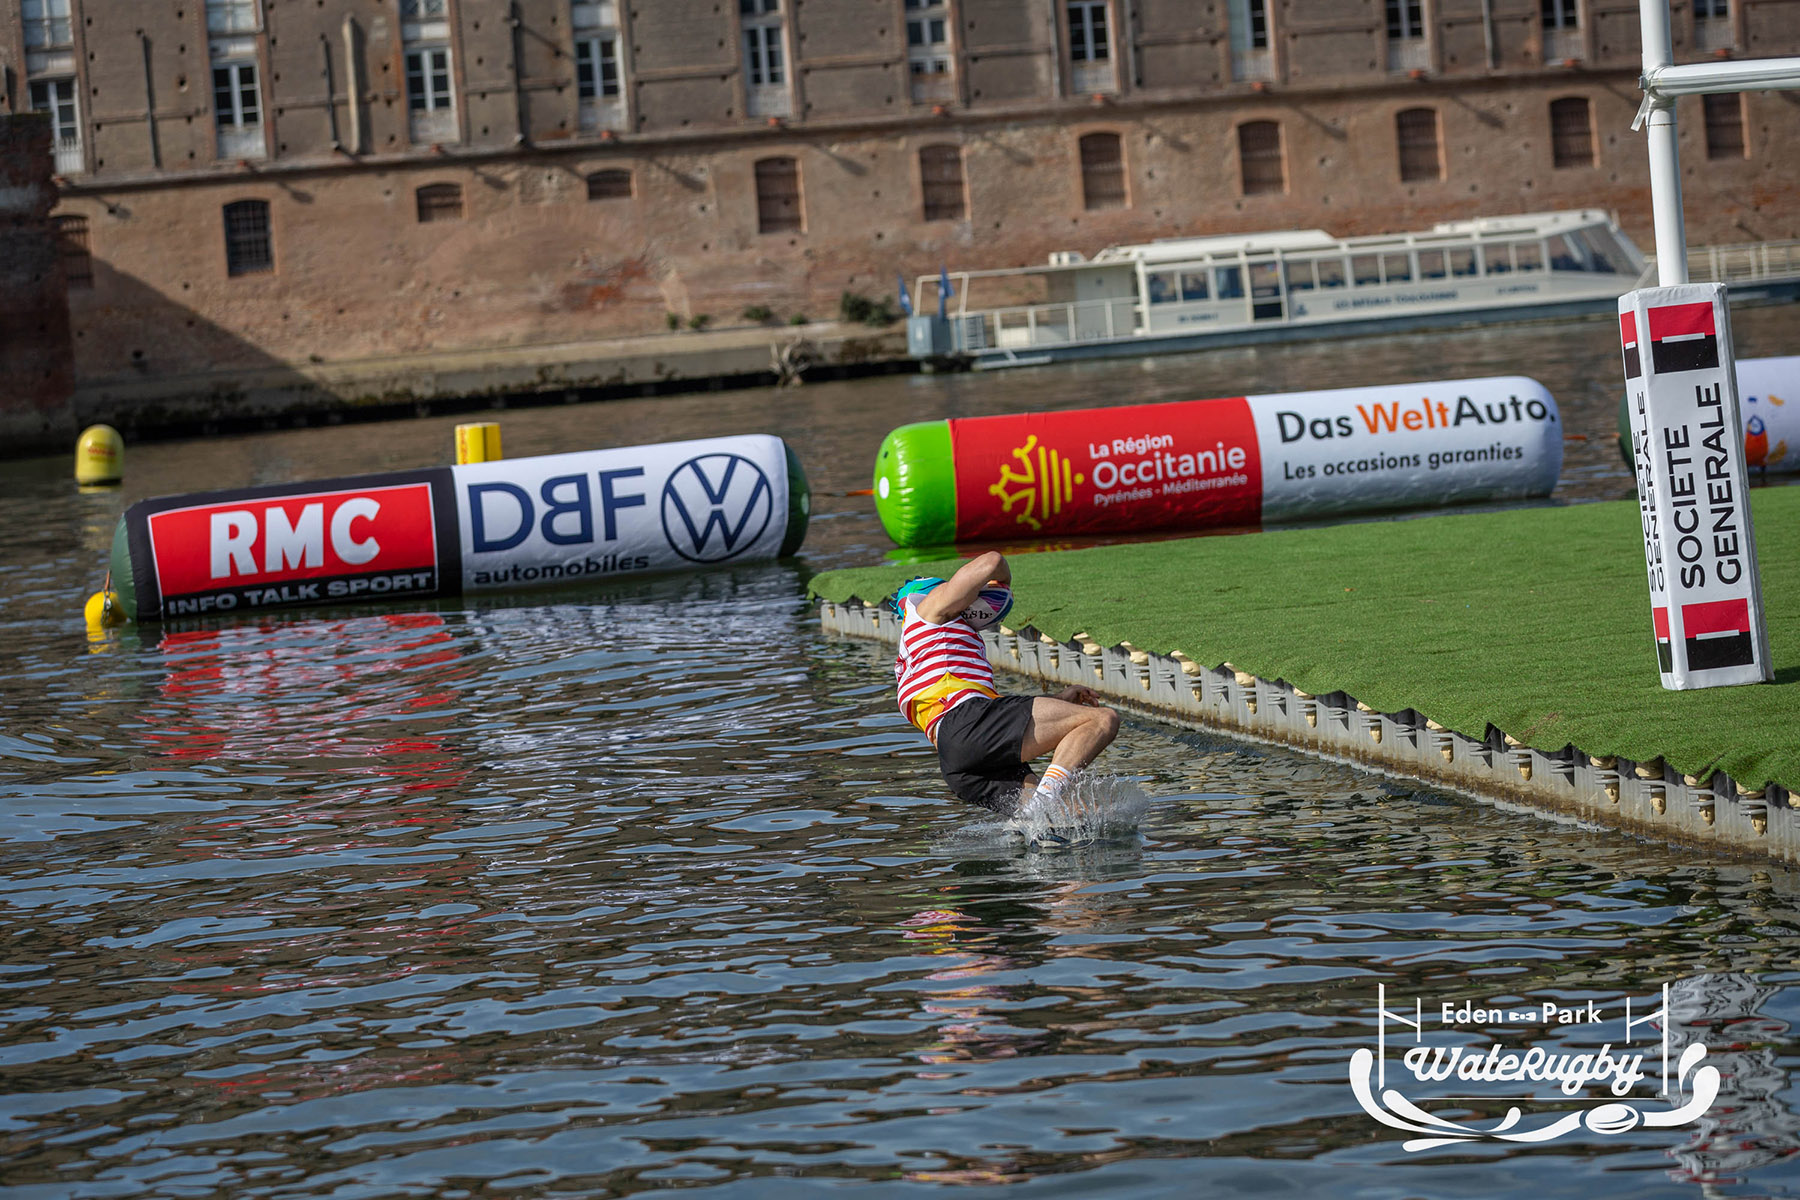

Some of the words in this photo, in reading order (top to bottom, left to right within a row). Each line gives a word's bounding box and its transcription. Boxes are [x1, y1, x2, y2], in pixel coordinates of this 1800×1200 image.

[1089, 443, 1109, 459] La
[1112, 434, 1174, 455] Région
[1276, 410, 1353, 443] Das
[1092, 441, 1247, 489] Occitanie
[1284, 461, 1316, 480] Les
[1323, 452, 1420, 476] occasions
[1429, 441, 1523, 470] garanties
[1094, 487, 1153, 506] Pyrénées
[1162, 472, 1248, 495] Méditerranée
[1637, 391, 1664, 592] GENERALE
[1695, 382, 1742, 585] GENERALE
[1633, 431, 1656, 592] SOCIETE
[1664, 425, 1706, 589] SOCIETE
[210, 497, 381, 580] RMC
[474, 554, 650, 585] automobiles
[169, 593, 237, 615] INFO
[244, 583, 320, 605] TALK
[327, 572, 432, 595] SPORT
